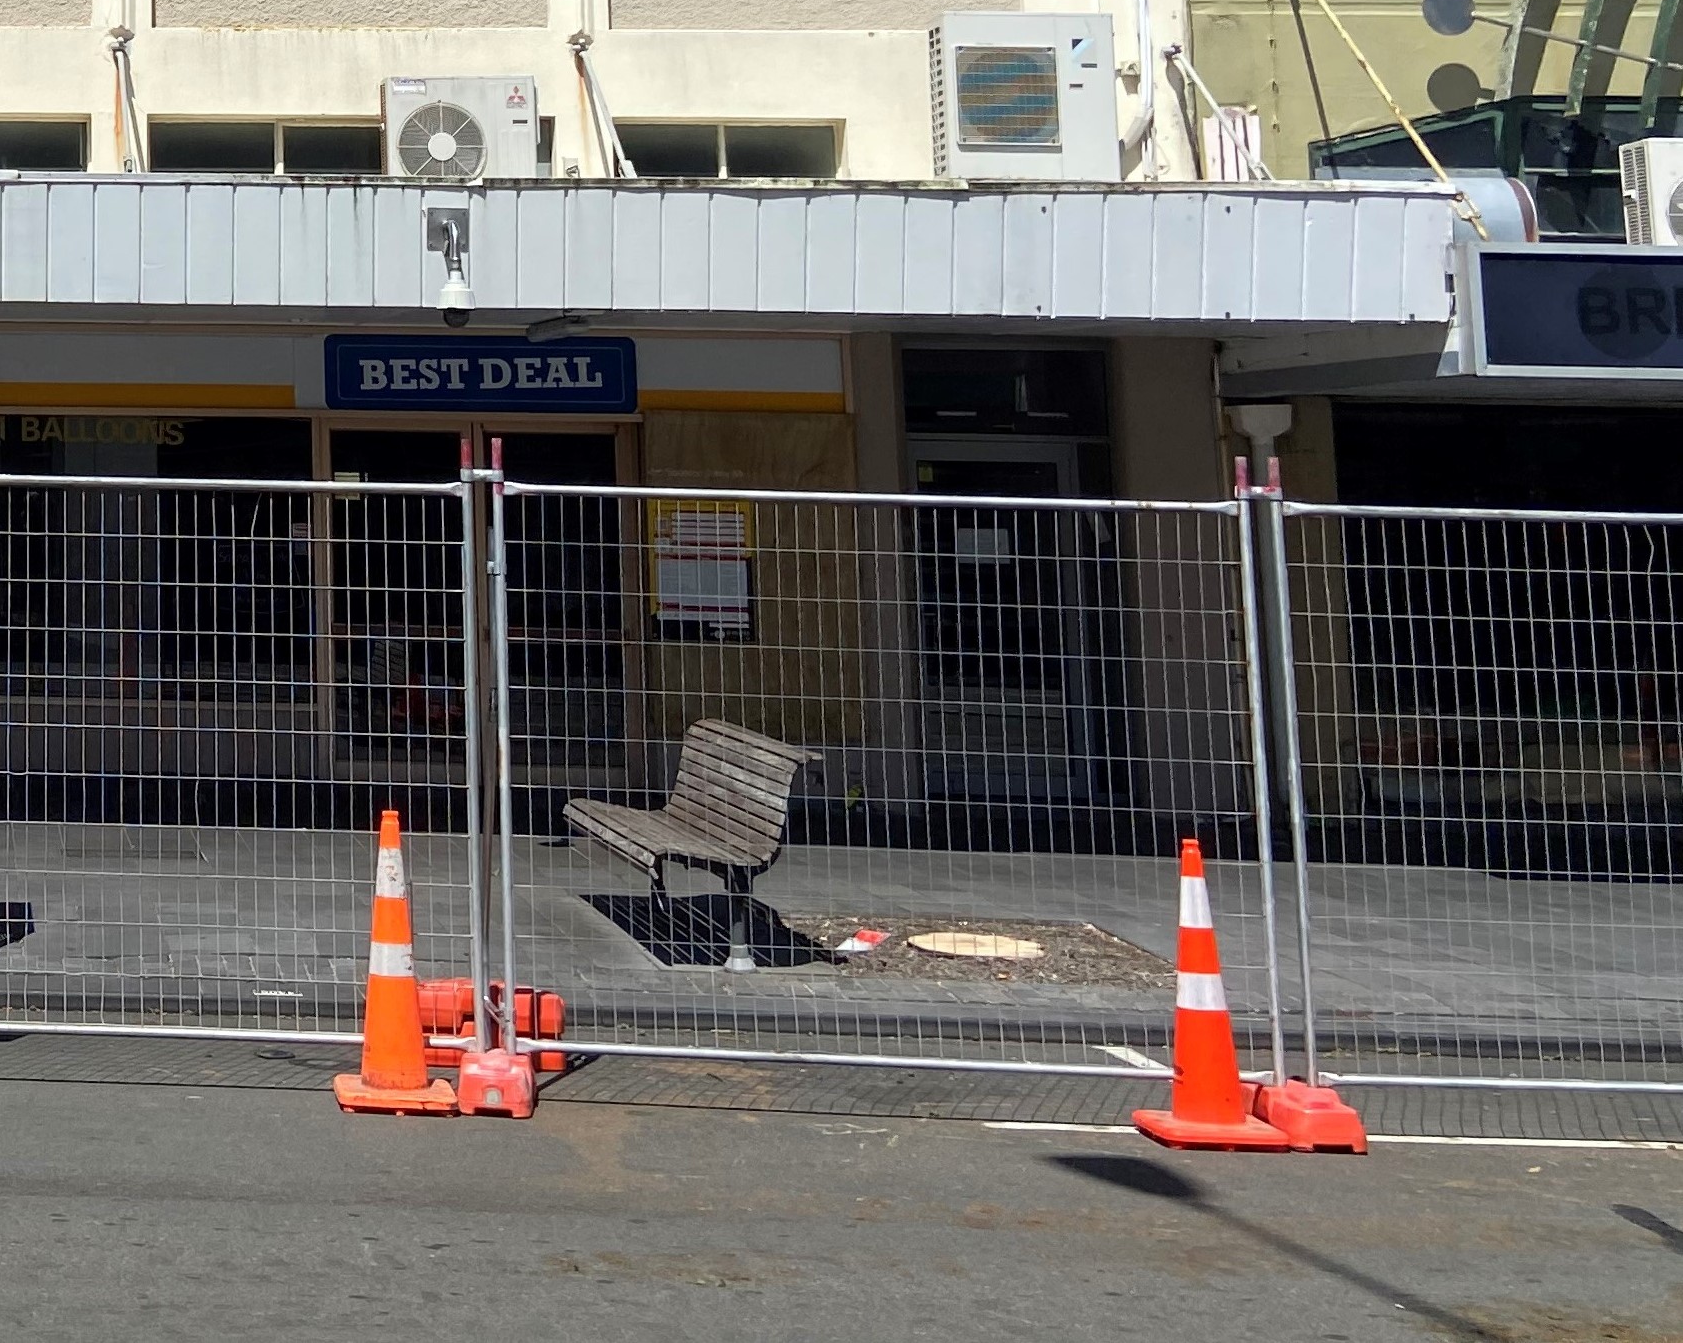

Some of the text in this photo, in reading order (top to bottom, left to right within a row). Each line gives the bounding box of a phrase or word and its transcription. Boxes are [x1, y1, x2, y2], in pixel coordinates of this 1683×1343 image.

[1577, 287, 1683, 337] BR
[359, 356, 603, 391] BEST DEAL
[21, 415, 185, 446] BALLOONS
